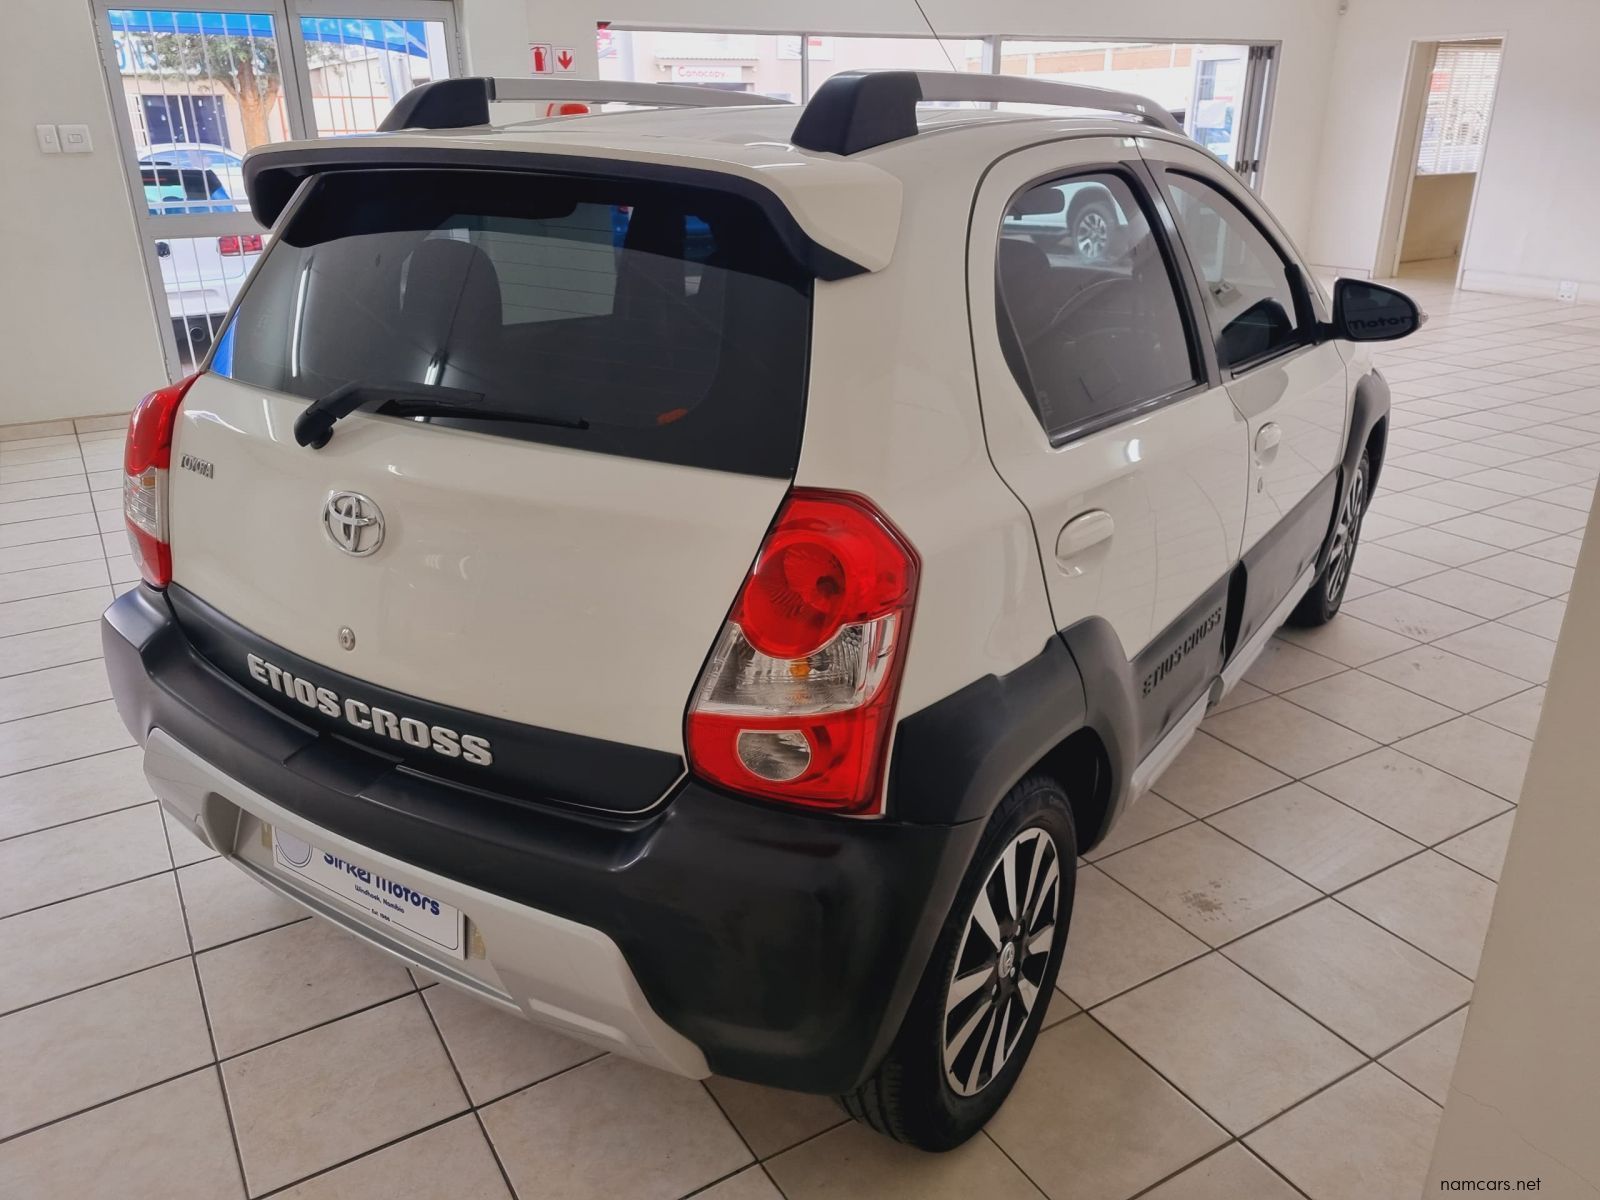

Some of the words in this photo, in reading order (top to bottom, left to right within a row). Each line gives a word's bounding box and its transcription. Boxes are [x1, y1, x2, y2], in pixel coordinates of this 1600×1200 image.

[180, 454, 214, 479] TOYOTA
[1142, 645, 1182, 697] ETIOS
[1183, 607, 1222, 656] CROSS
[247, 653, 342, 718] ETIOS
[345, 698, 493, 767] CROSS
[382, 898, 405, 914] Namibia
